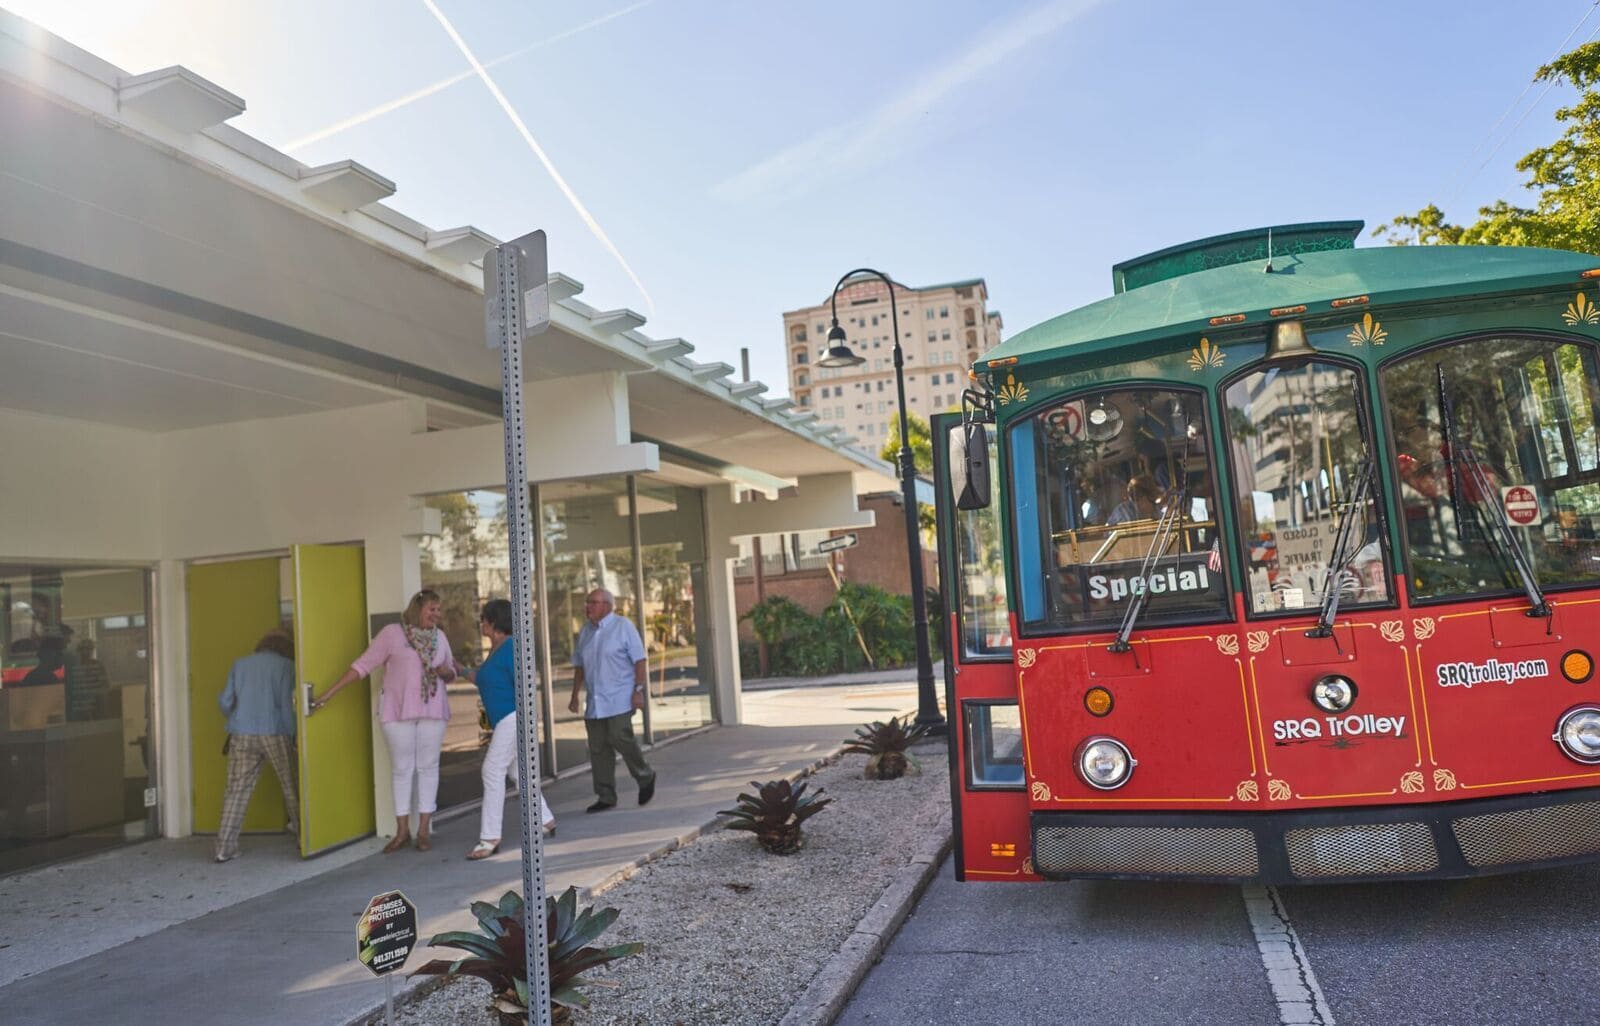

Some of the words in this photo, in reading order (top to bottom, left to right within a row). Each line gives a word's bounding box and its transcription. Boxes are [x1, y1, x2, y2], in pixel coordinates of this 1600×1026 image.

[1089, 564, 1209, 601] Special
[1437, 659, 1548, 688] SRQtrolley.com
[1273, 718, 1322, 740] SRQ
[369, 906, 407, 923] PROTECTED
[371, 899, 403, 914] PREMISES
